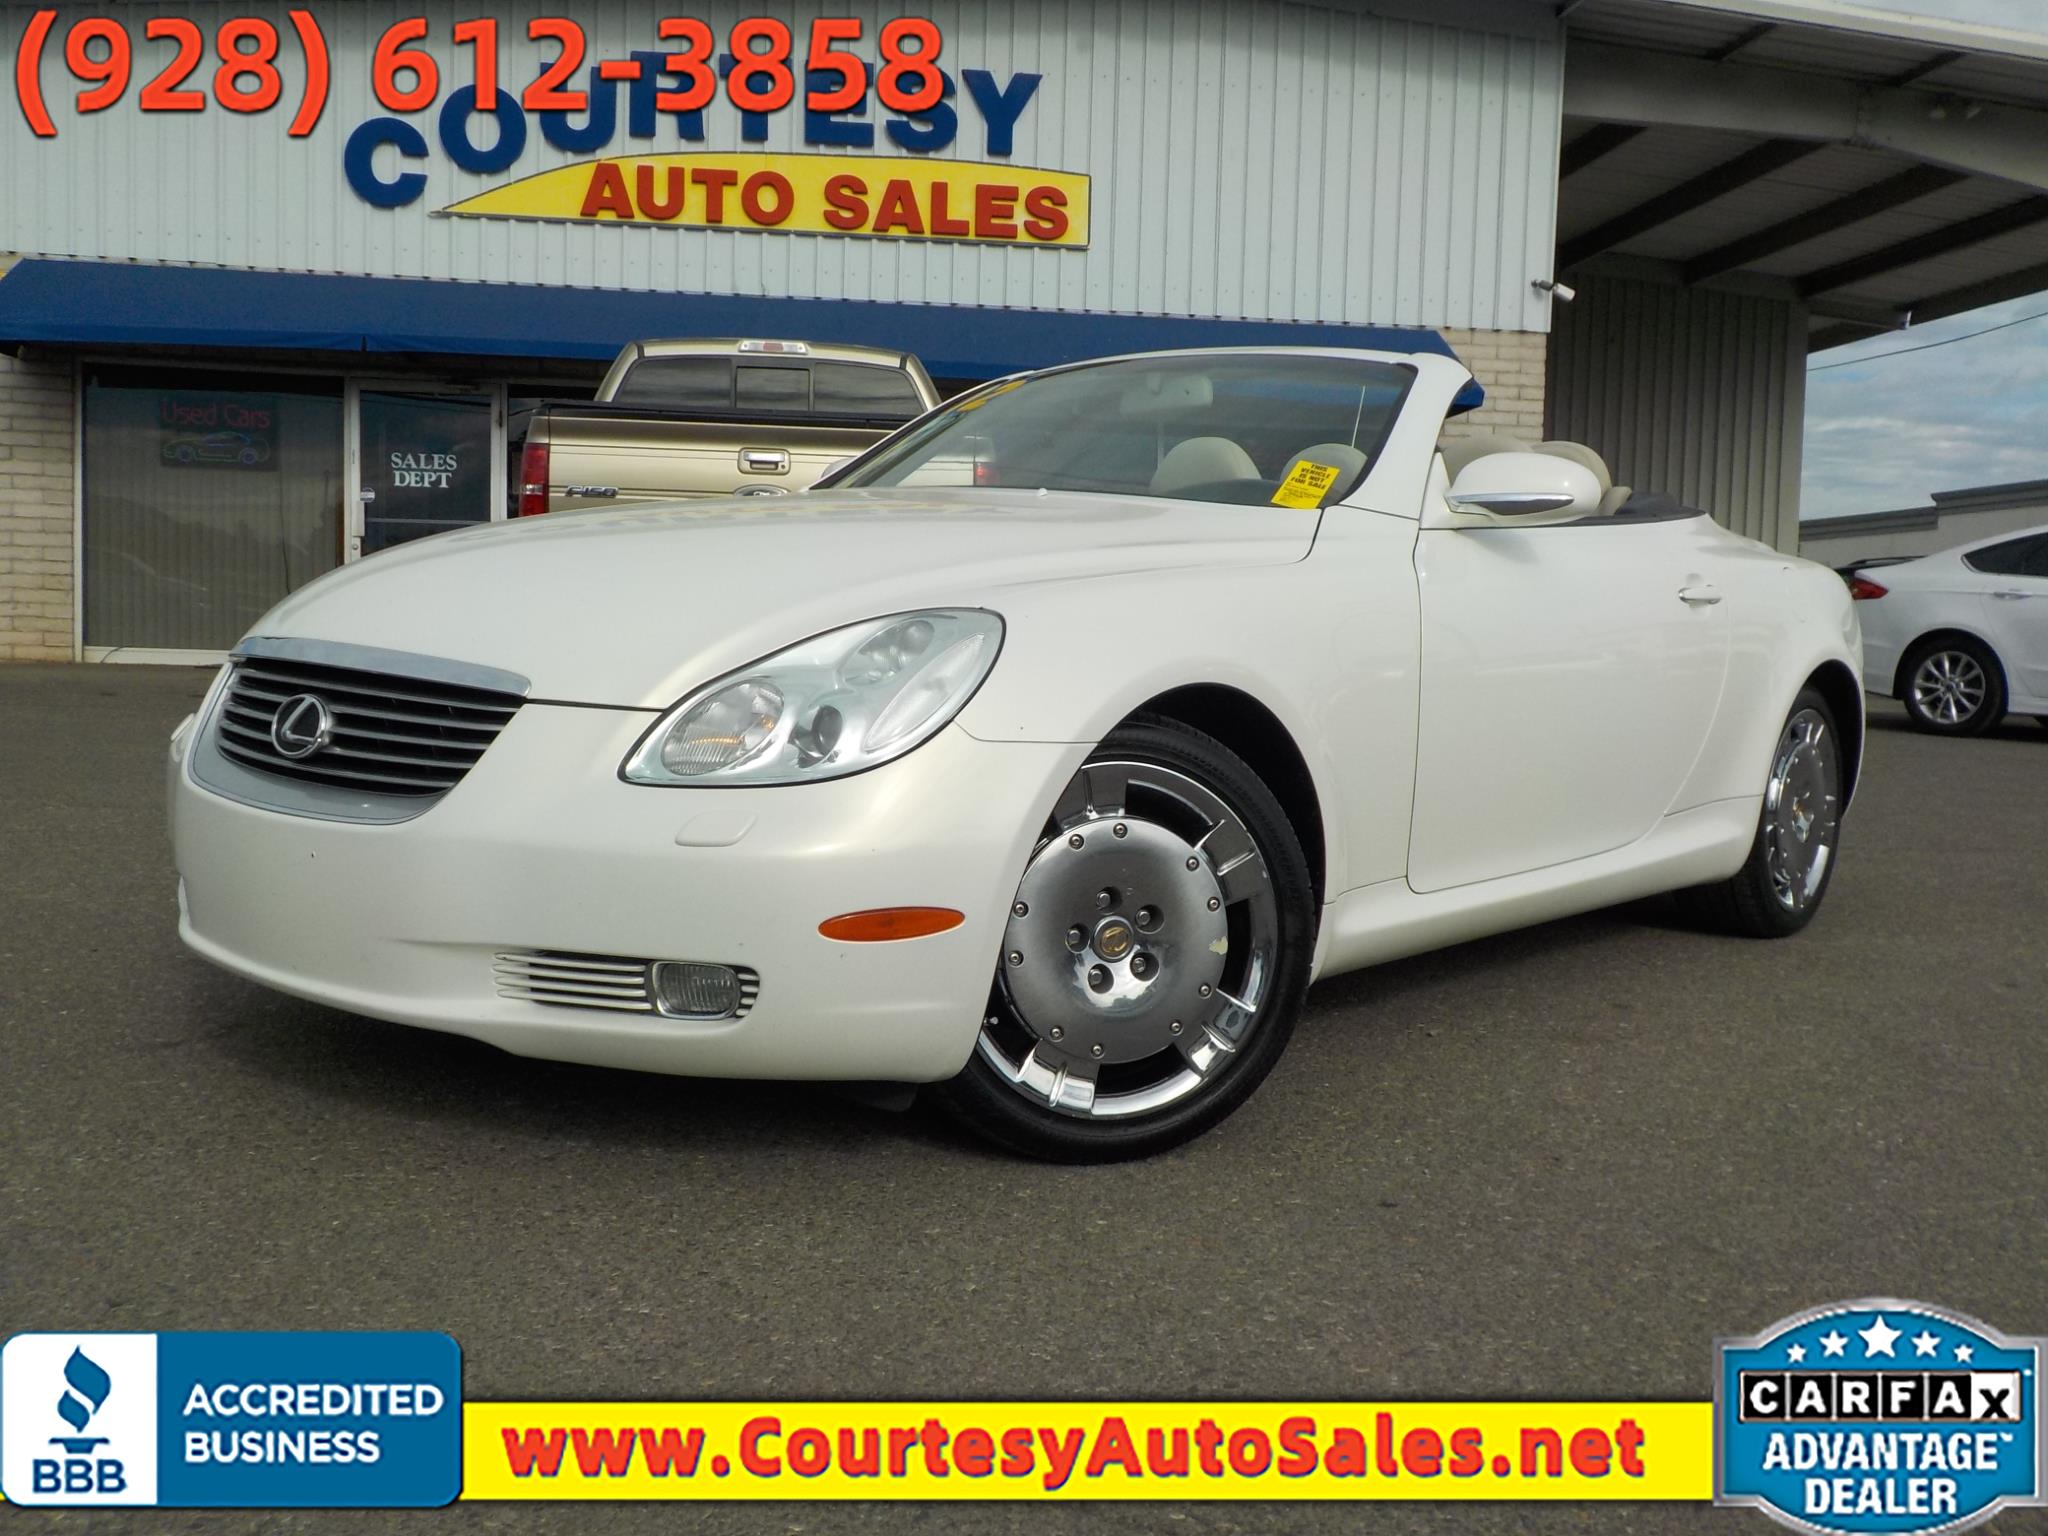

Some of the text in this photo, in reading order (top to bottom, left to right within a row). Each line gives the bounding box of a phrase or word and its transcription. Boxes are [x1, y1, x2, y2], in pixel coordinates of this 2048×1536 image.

[579, 161, 1069, 240] AUTO SALES
[161, 397, 271, 429] Used Cars
[390, 451, 458, 471] SALES
[393, 470, 453, 489] DEPT
